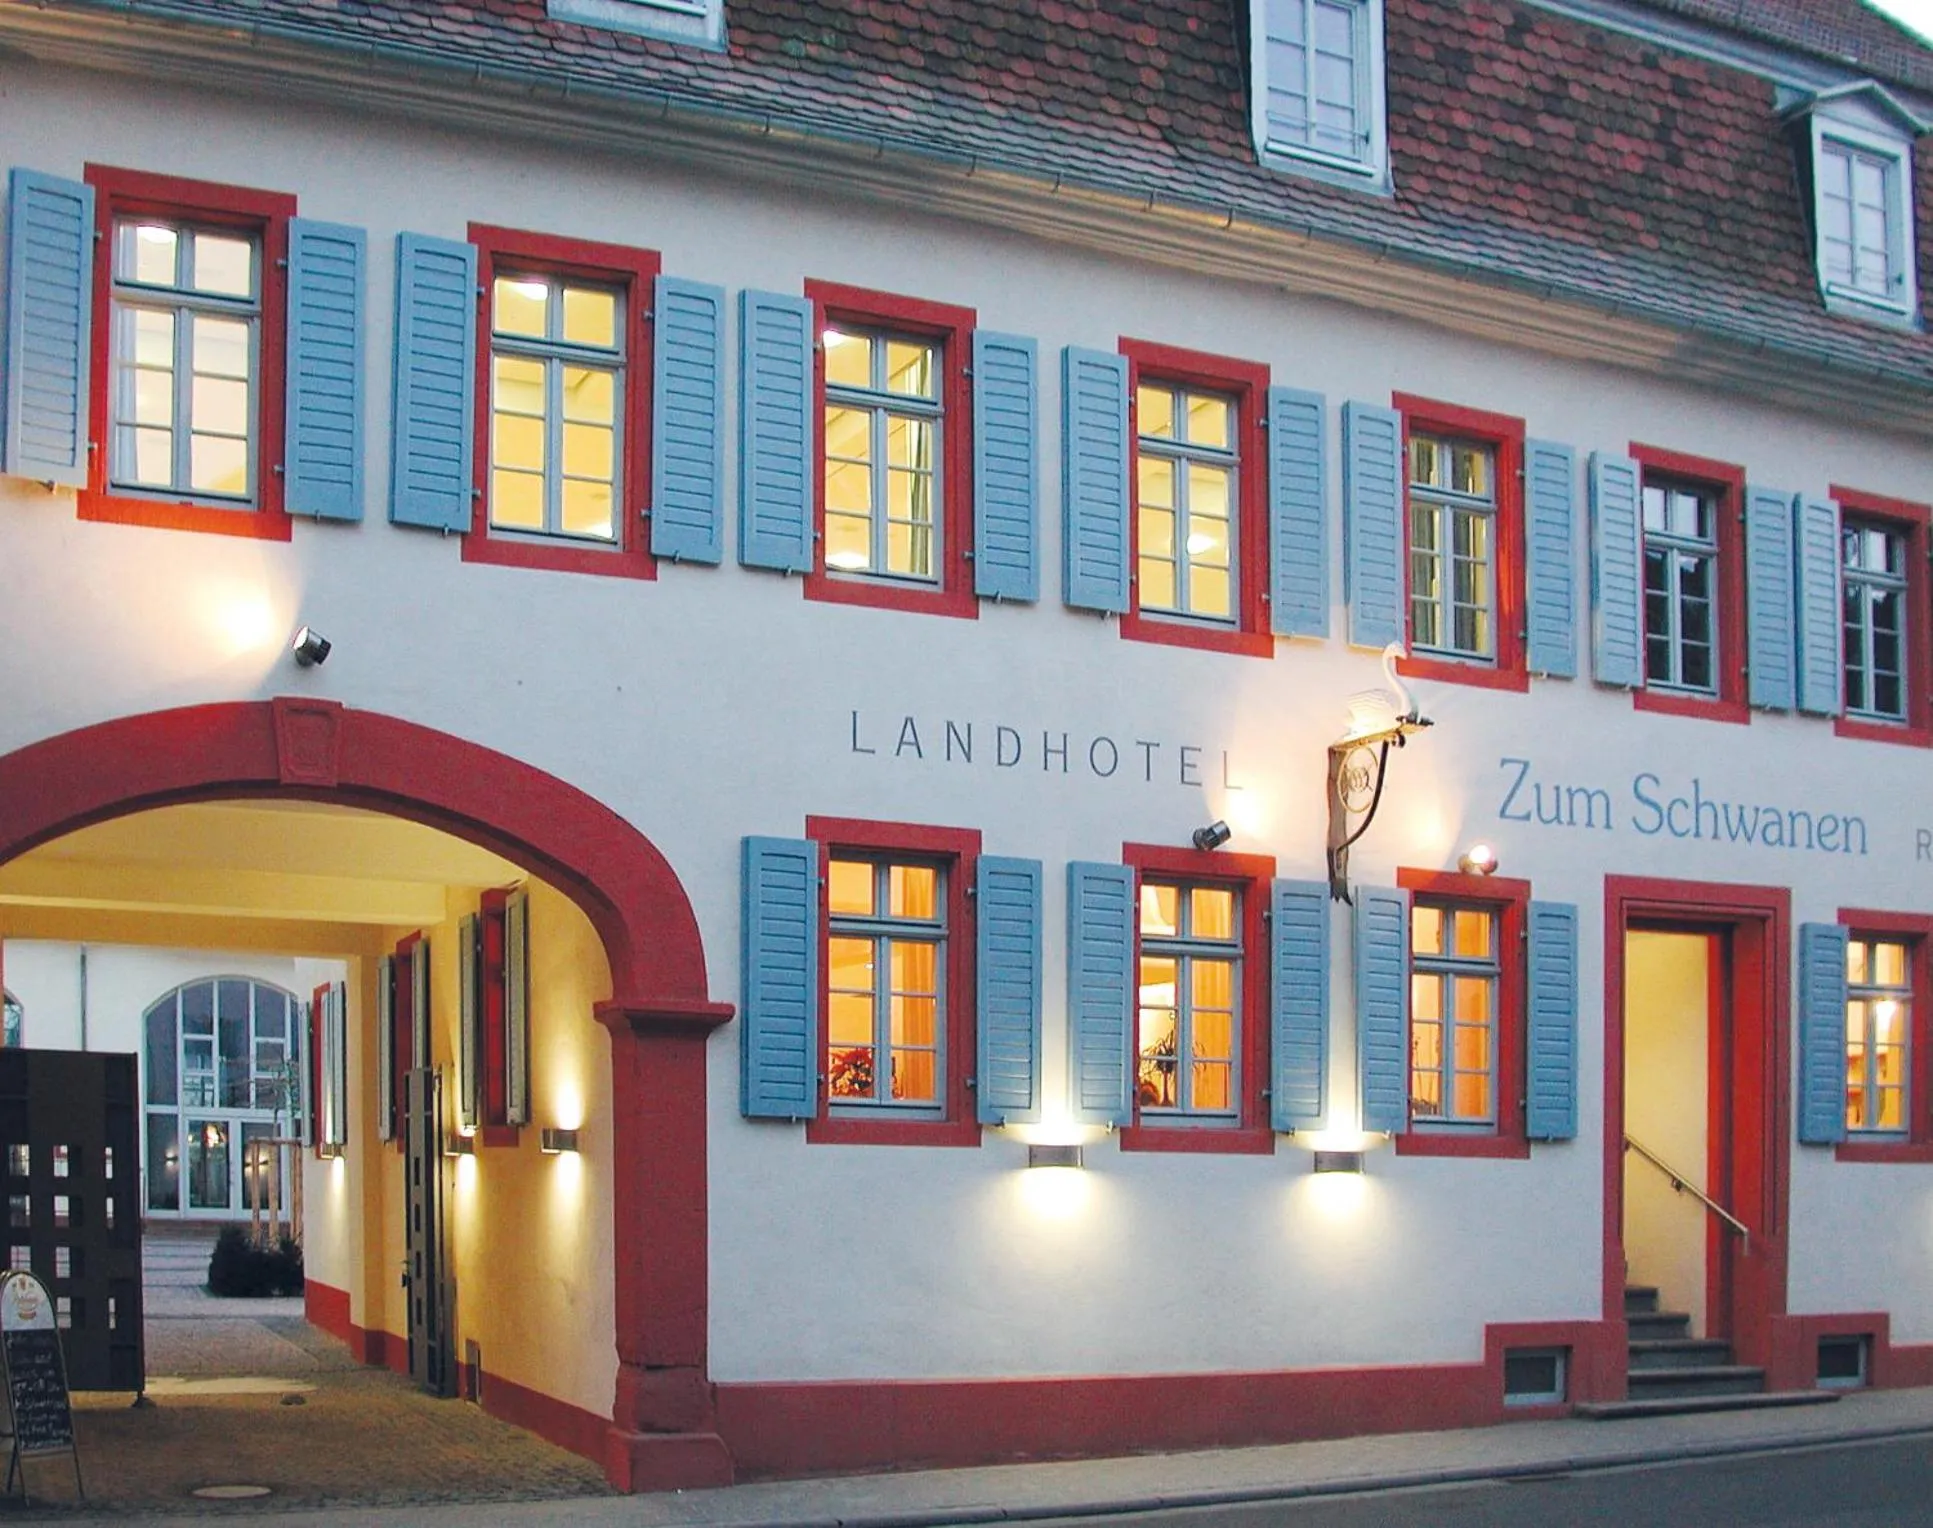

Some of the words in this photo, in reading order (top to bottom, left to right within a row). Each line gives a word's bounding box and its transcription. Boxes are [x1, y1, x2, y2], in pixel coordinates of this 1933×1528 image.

[851, 710, 1243, 791] LANDHOTEL
[1499, 758, 1614, 829] Zum
[1631, 772, 1869, 855] Schwanen
